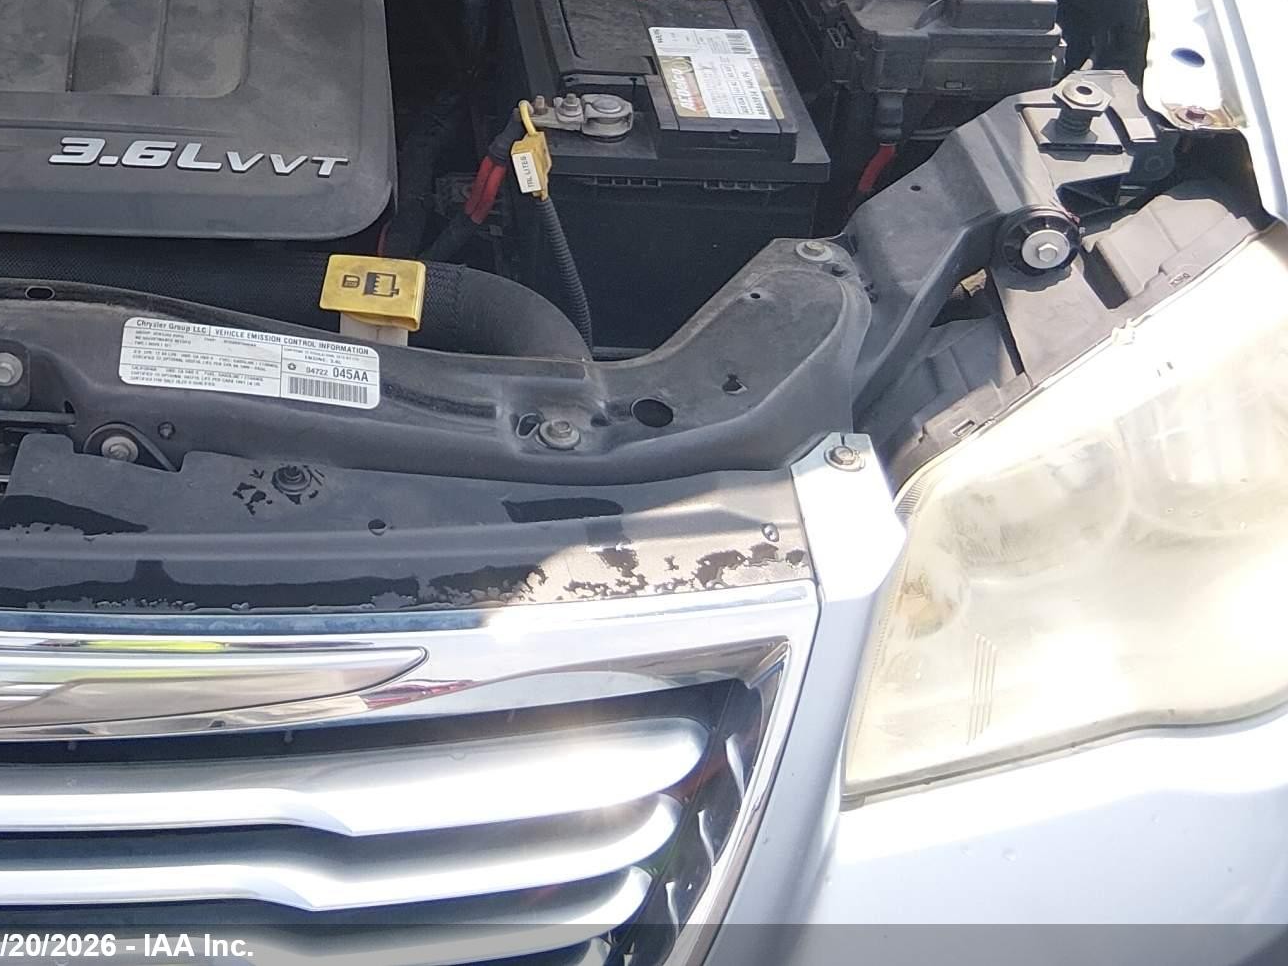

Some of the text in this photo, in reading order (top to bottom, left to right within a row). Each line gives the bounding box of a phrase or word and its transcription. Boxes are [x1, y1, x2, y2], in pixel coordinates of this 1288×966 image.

[48, 136, 350, 178] 3.6L VVT
[136, 319, 207, 334] Chrysler Group LLC
[215, 328, 246, 338] VEHICLE
[246, 332, 281, 343] EMISSION
[283, 337, 317, 348] CONTROL
[318, 340, 369, 355] INFORMATION
[305, 366, 329, 377] 04722
[331, 366, 369, 382] 045AA
